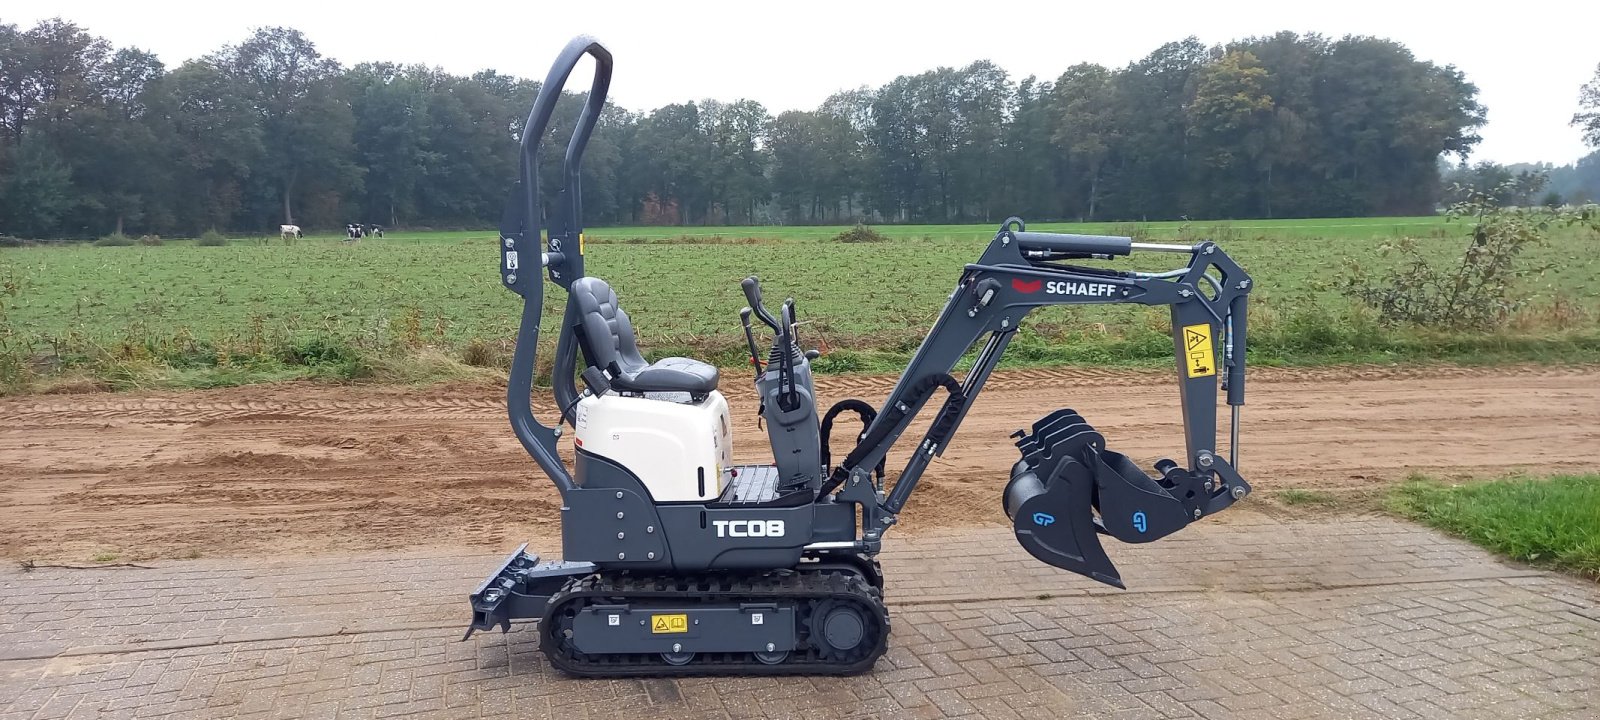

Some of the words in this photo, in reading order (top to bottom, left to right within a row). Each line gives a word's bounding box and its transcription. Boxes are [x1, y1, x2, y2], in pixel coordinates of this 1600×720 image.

[1046, 281, 1117, 297] SCHAEFF
[1033, 512, 1056, 527] GP
[1132, 511, 1148, 533] GP
[713, 520, 785, 538] TC08
